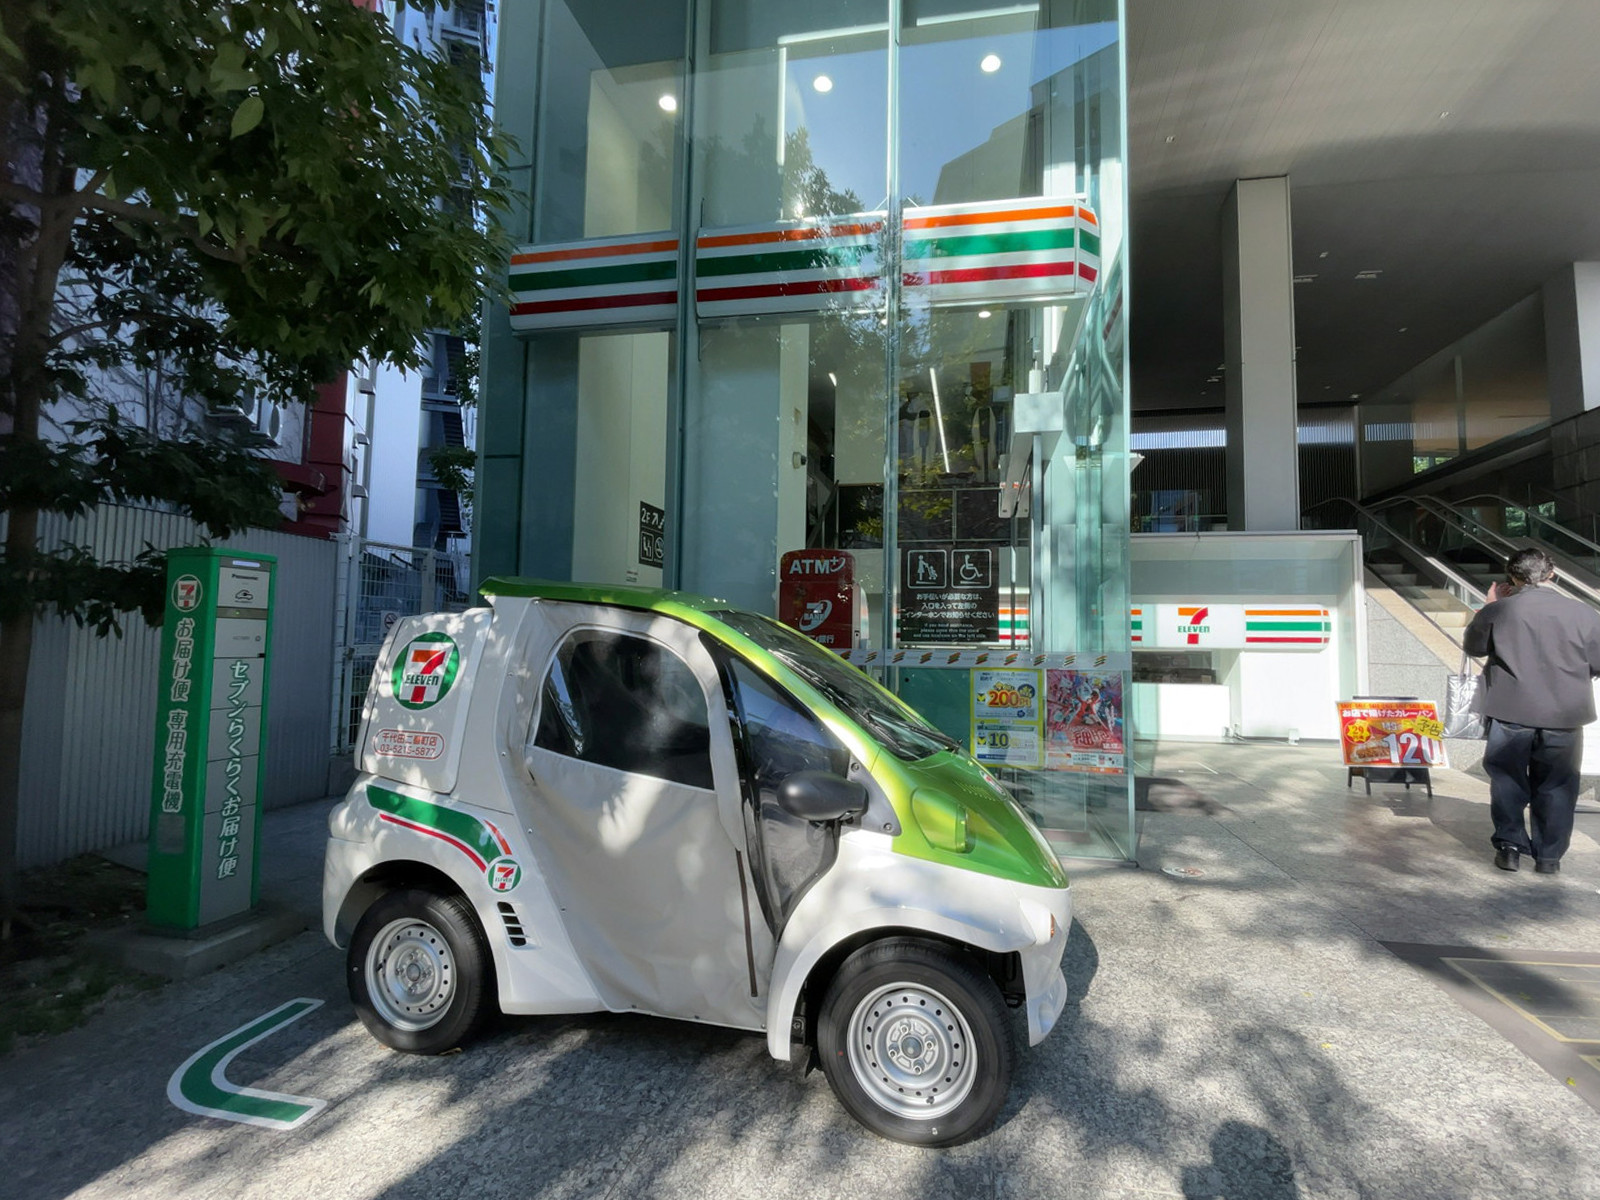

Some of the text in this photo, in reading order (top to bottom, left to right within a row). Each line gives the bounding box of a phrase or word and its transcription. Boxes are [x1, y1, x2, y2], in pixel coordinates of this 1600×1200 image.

[1178, 607, 1209, 645] 7
[172, 618, 195, 702] お届け便
[411, 649, 447, 703] 7
[162, 709, 188, 813] 専用充電機
[379, 743, 436, 757] 03-5215-5877
[382, 732, 438, 747] 千代田二番町店
[217, 660, 249, 880] セブンらくらくお届け便
[497, 866, 515, 889] 7
